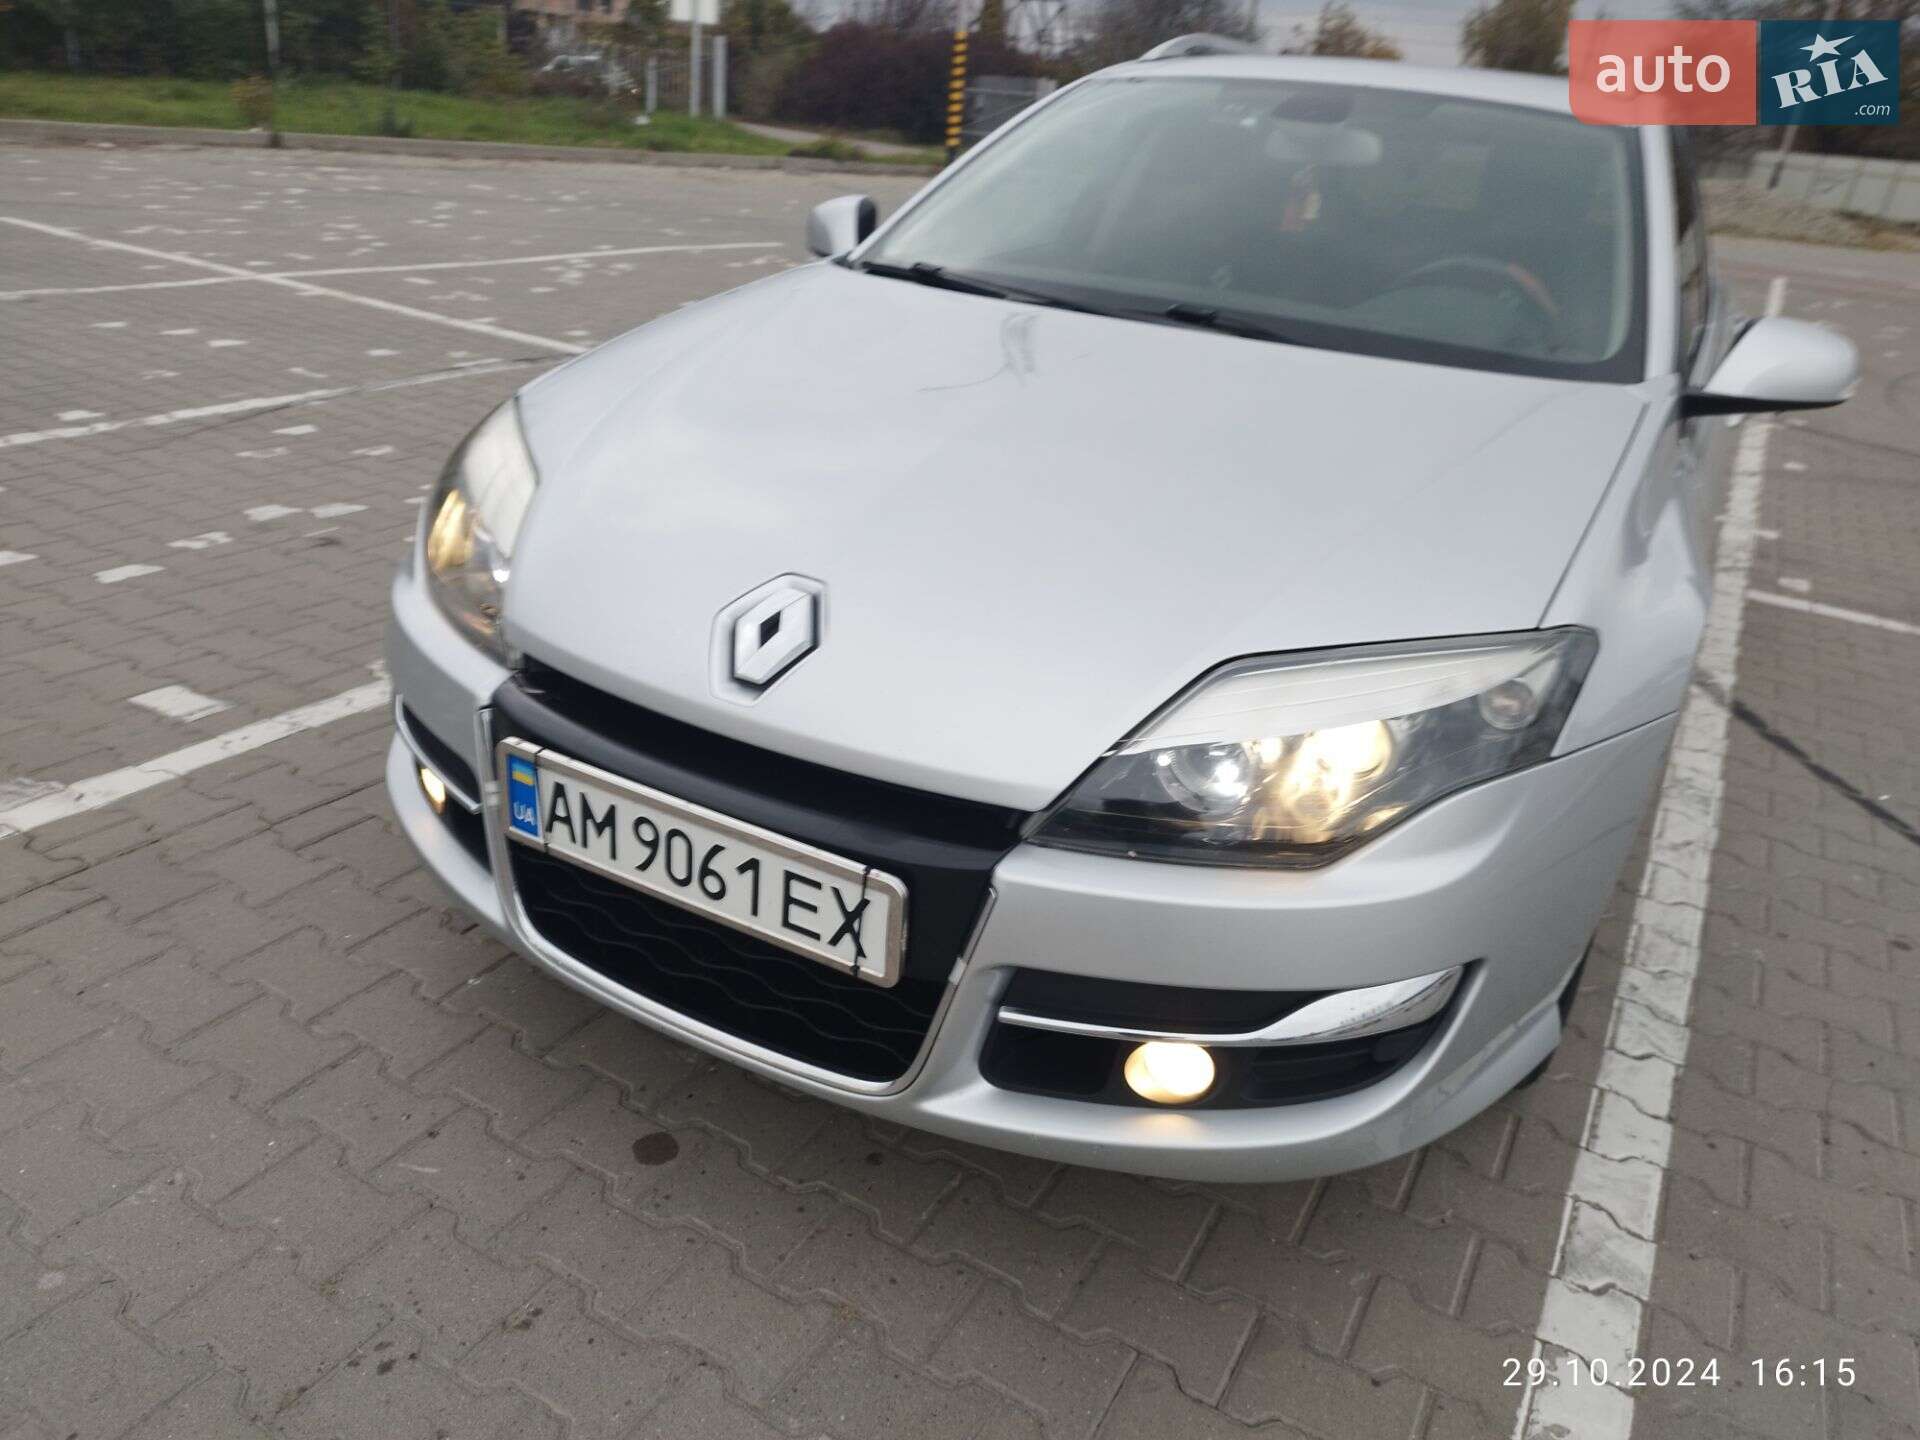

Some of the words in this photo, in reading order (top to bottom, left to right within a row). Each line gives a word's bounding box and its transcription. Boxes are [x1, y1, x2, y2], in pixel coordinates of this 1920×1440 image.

[514, 801, 536, 826] UA
[545, 782, 617, 861] AM
[632, 815, 761, 918] 9061
[781, 868, 871, 959] EX
